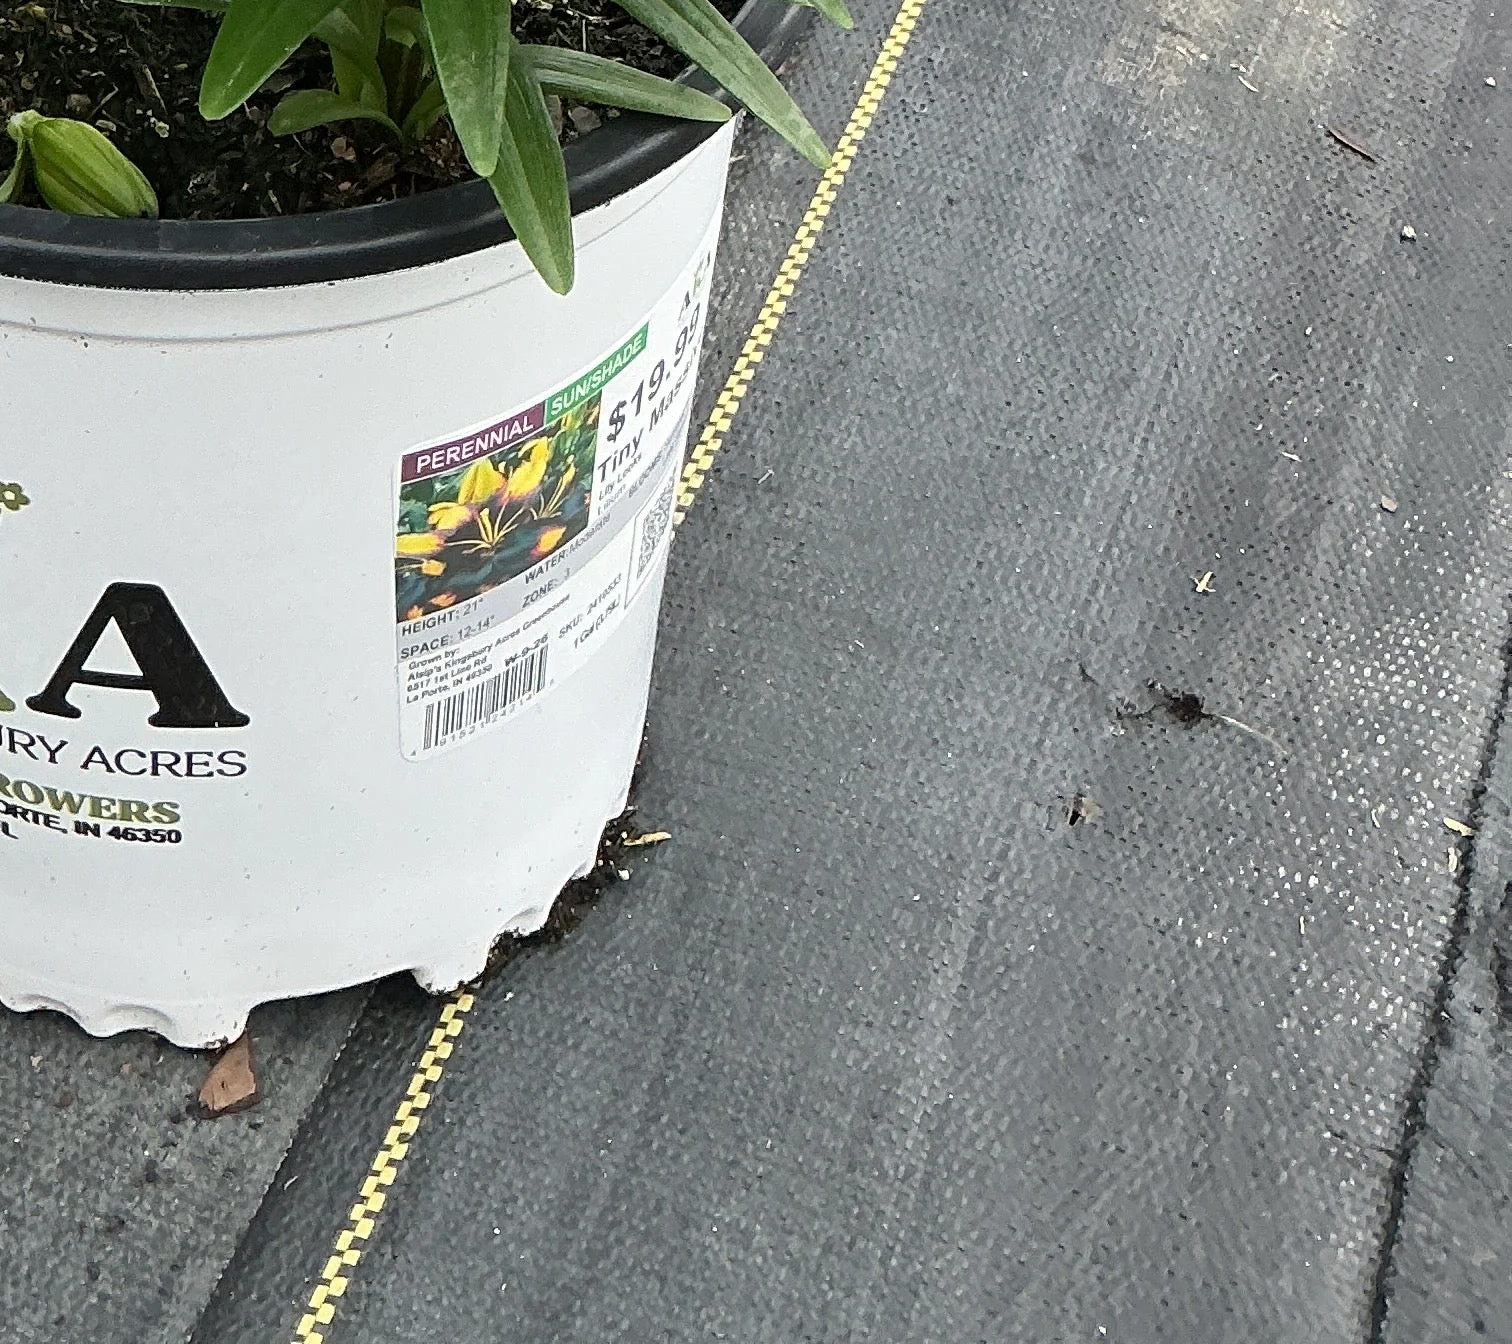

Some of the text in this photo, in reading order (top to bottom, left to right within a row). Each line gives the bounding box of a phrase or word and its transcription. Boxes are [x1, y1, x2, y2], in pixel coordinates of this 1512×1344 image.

[606, 301, 700, 444] $19.99
[416, 332, 644, 474] PERENNIAL SUN/SHADE
[597, 427, 644, 483] Tiny
[524, 550, 569, 585] WATER:
[402, 610, 460, 637] HEIGHT:
[400, 634, 454, 660] SPACE:
[408, 653, 443, 671] Grown
[406, 691, 419, 705] La
[80, 745, 249, 778] ACRES
[0, 823, 19, 840] L
[74, 819, 100, 838] IN
[107, 825, 183, 844] 46350
